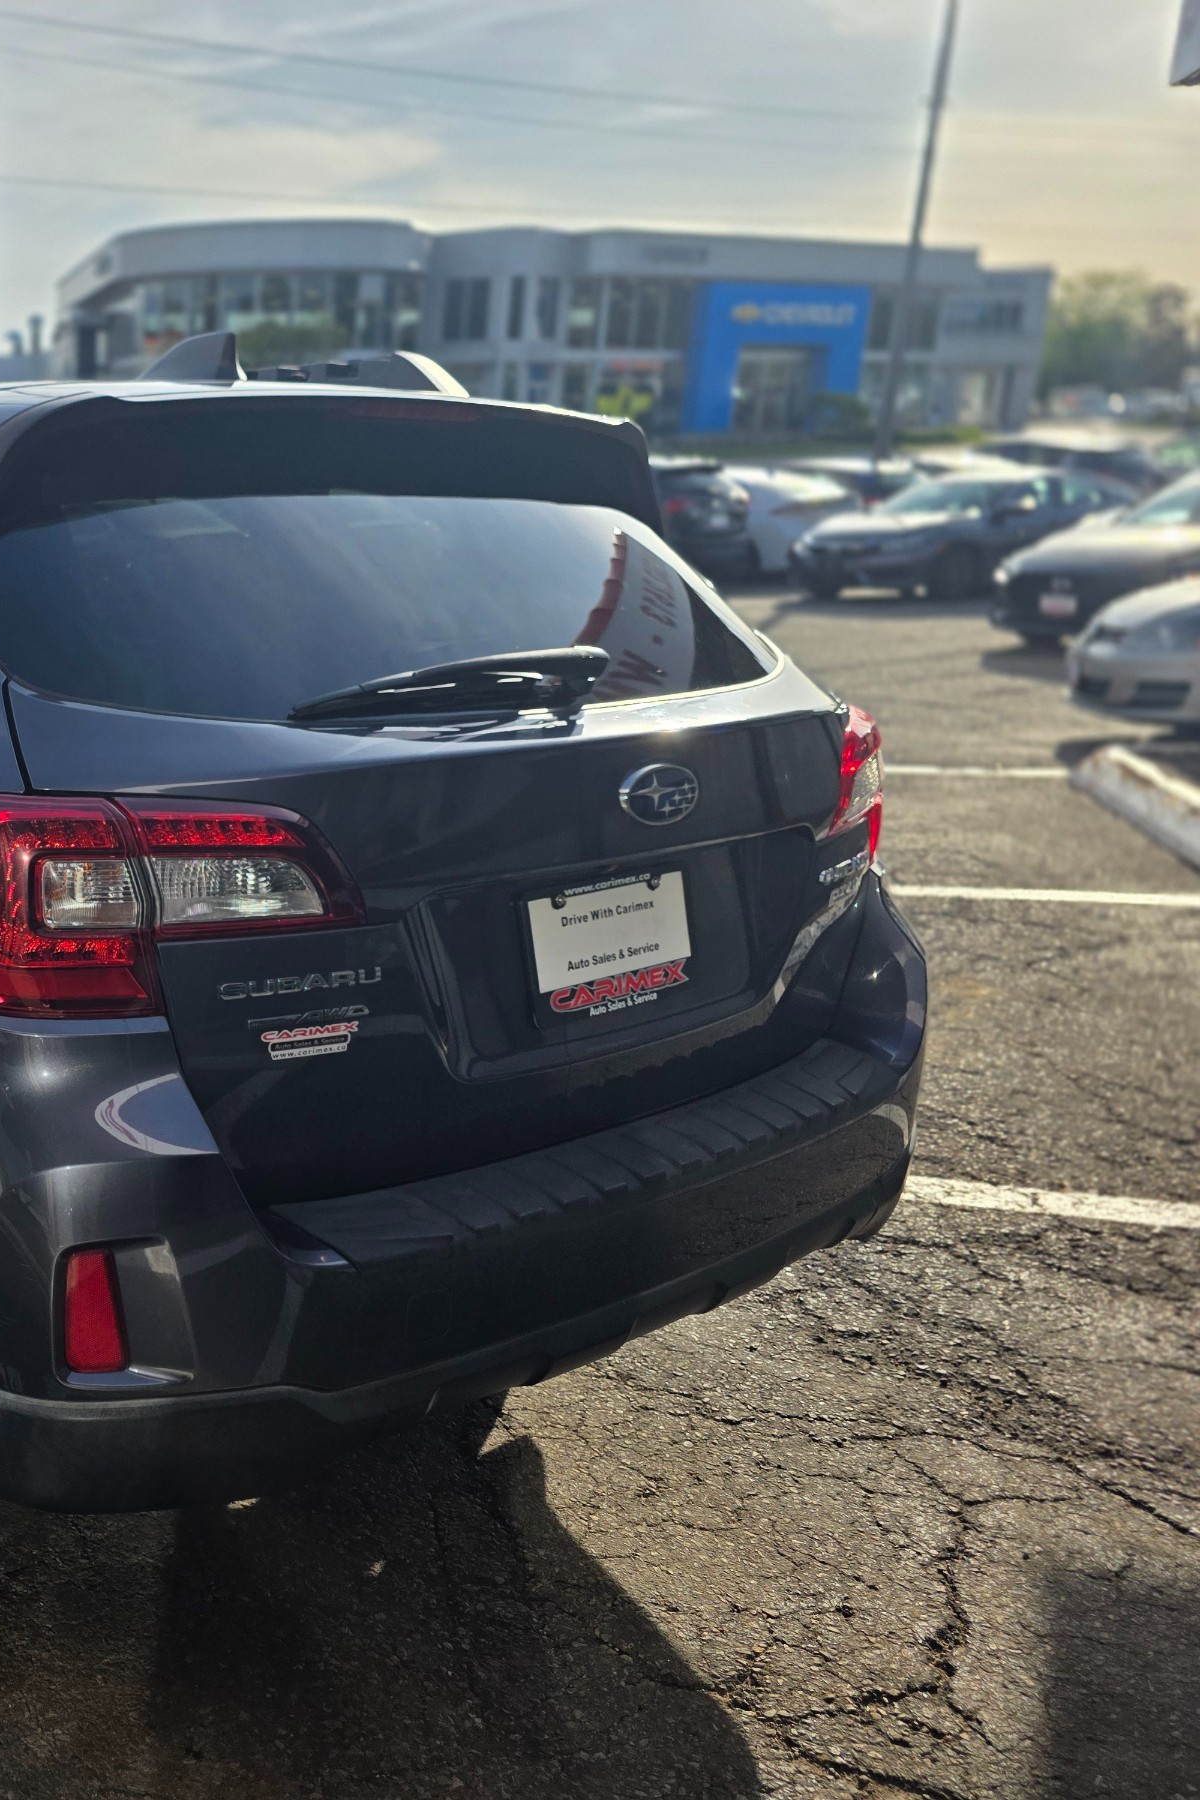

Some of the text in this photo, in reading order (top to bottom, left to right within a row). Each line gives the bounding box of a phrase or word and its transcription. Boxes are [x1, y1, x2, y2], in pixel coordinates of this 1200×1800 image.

[563, 872, 651, 896] www.carimex.ca
[561, 900, 654, 927] Drive With Carimex
[567, 942, 659, 971] Auto Sales & Service
[219, 966, 382, 1000] SUBARU
[551, 961, 688, 1012] CARIMEX
[297, 1005, 370, 1023] AWD
[590, 1004, 606, 1016] Auto
[607, 999, 626, 1011] Sales
[633, 992, 658, 1005] Service
[262, 1022, 358, 1041] CARIMEX
[272, 1045, 346, 1059] www.carimex.ca
[275, 1042, 292, 1050] Auto
